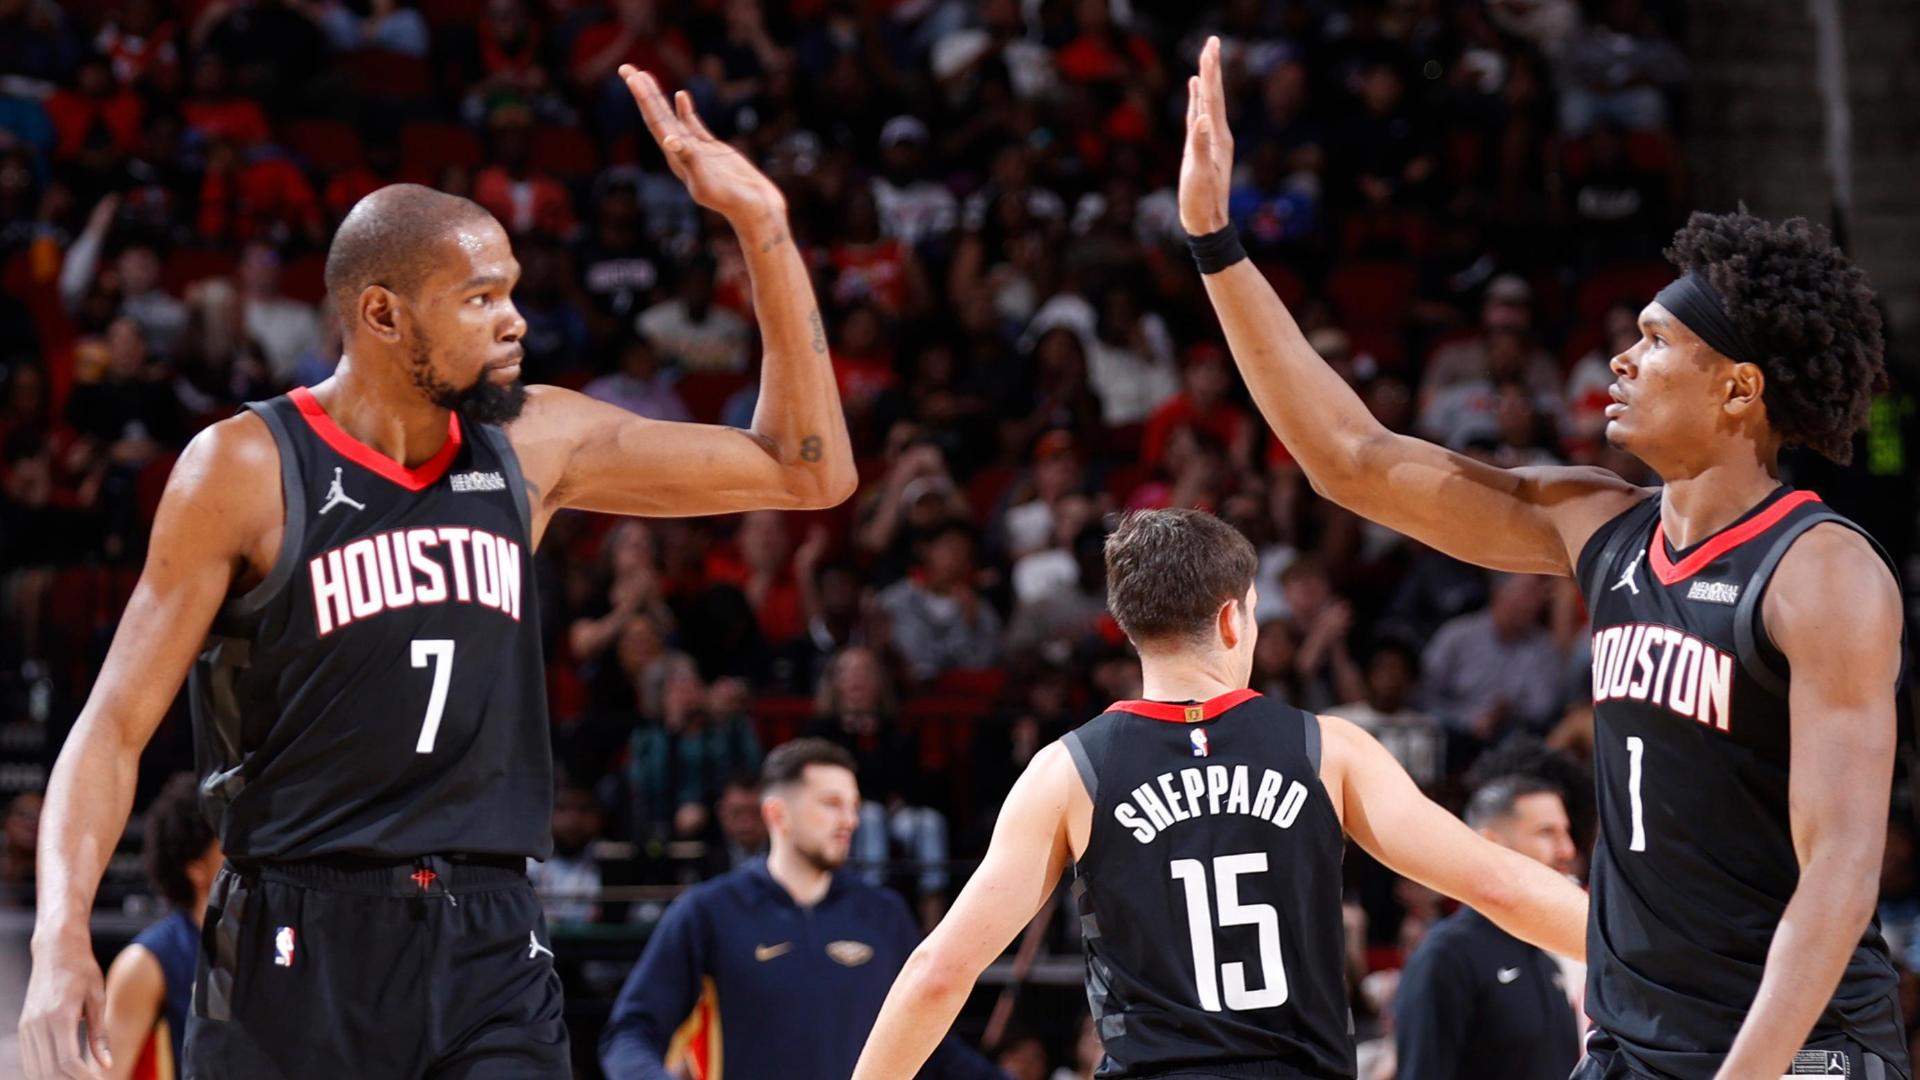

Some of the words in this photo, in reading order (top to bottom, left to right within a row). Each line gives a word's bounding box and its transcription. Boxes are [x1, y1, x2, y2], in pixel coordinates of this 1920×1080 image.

[308, 525, 522, 638] HOUSTON
[411, 639, 455, 754] 7
[1113, 765, 1309, 844] SHEPPARD
[1626, 736, 1646, 852] 1
[1170, 852, 1289, 1012] 15
